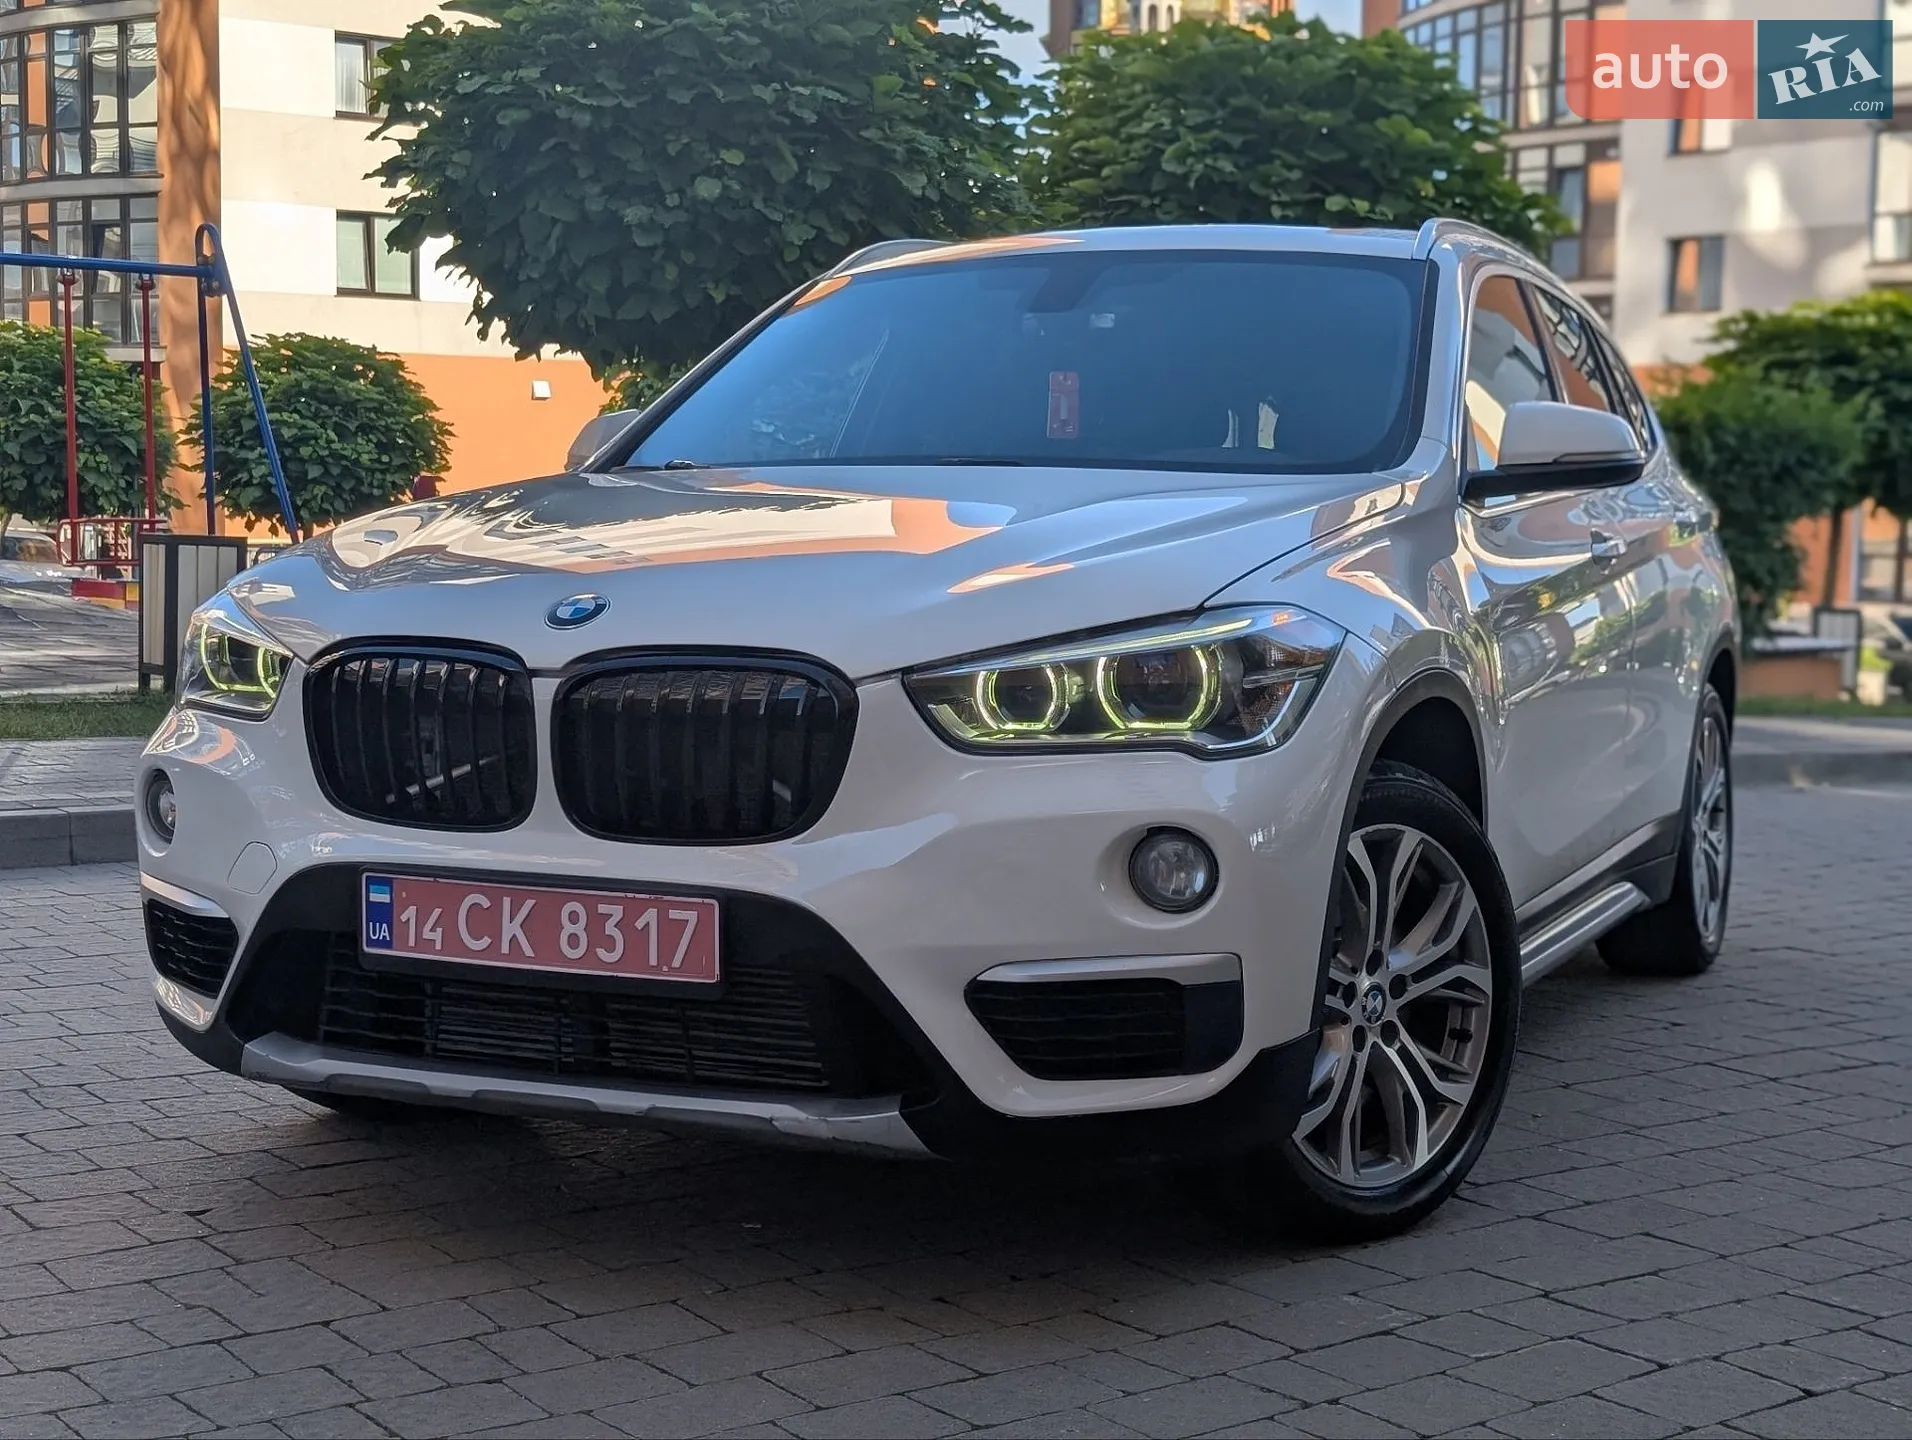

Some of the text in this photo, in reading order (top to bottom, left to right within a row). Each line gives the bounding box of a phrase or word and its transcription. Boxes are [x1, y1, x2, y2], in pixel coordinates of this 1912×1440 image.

[369, 921, 390, 941] UA
[400, 893, 699, 969] 14 CK 8317
